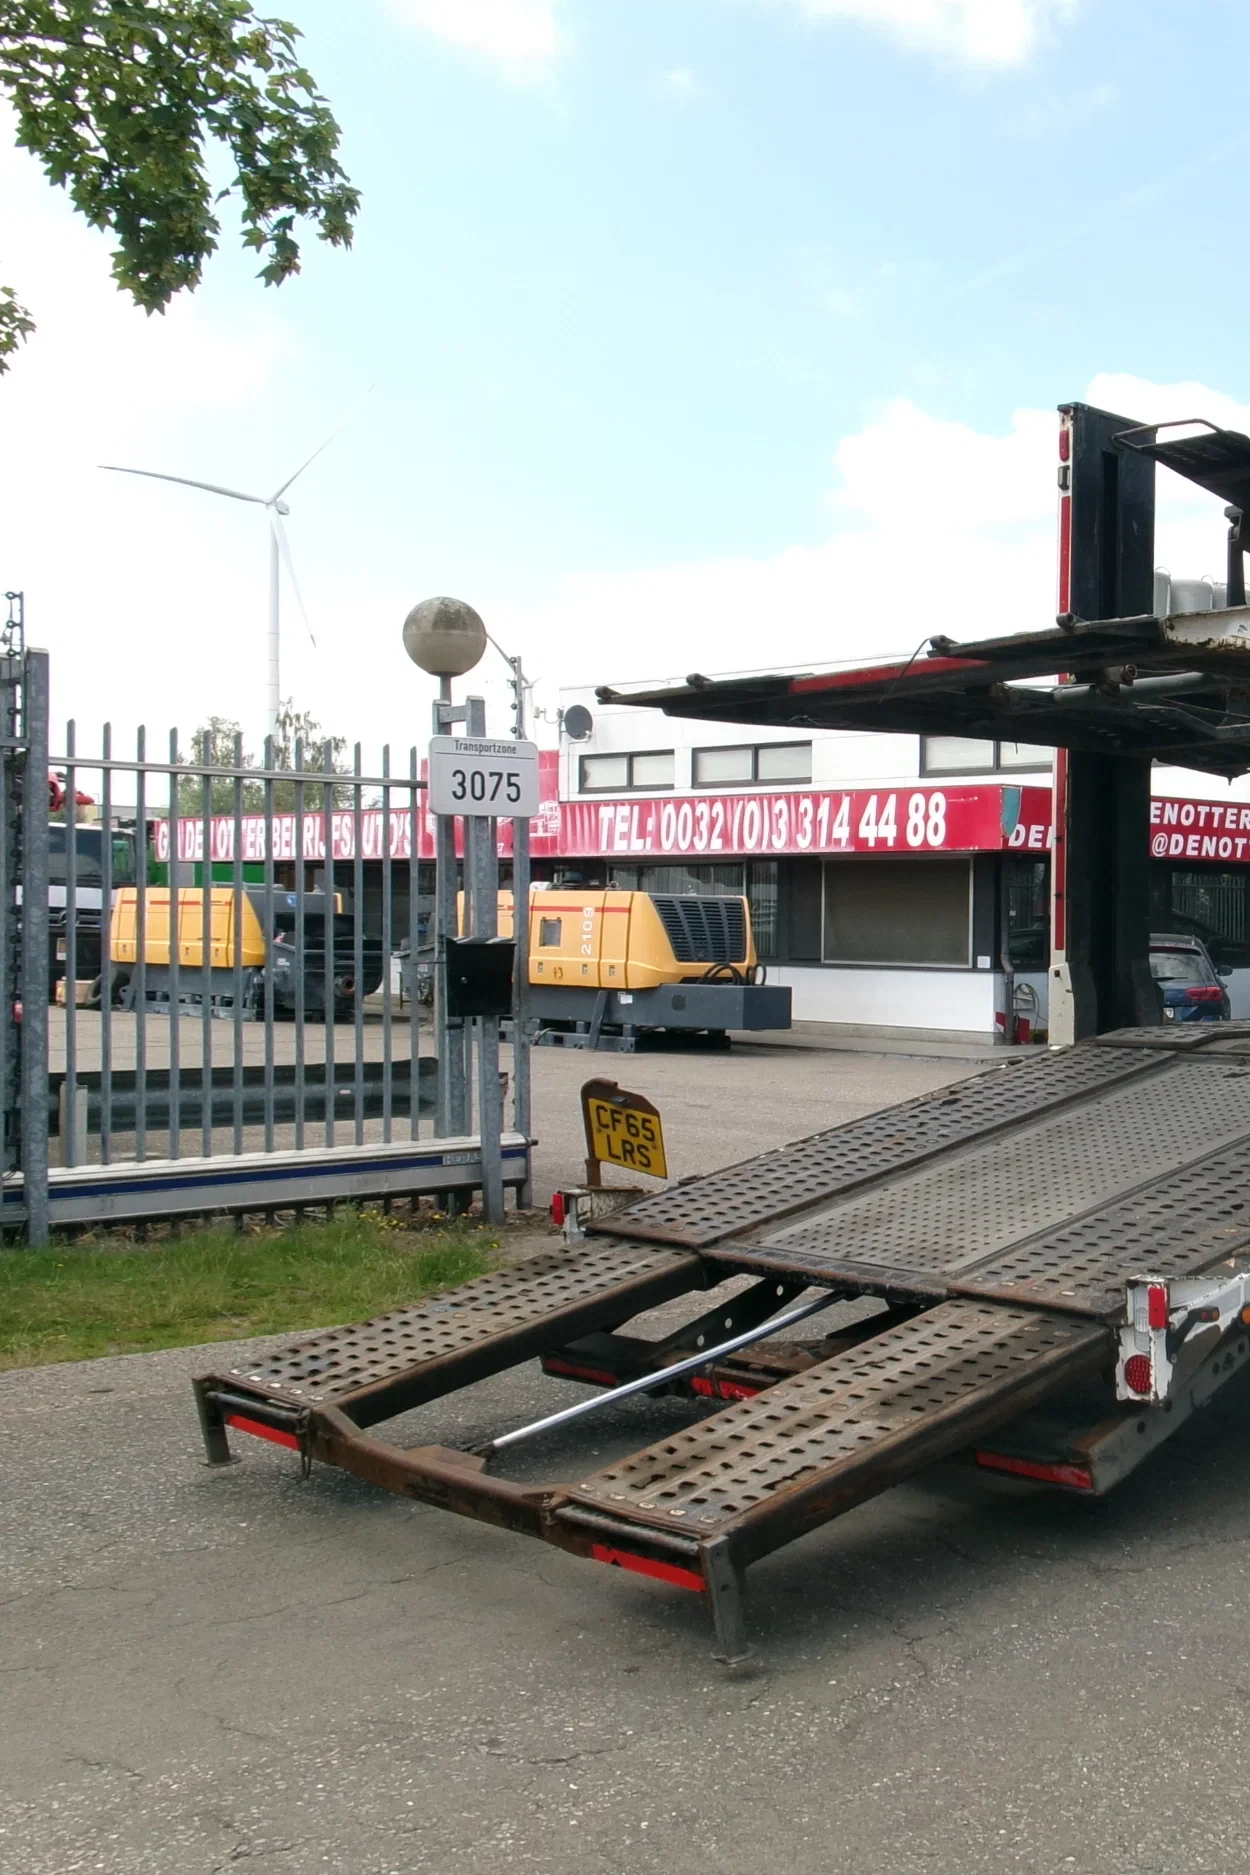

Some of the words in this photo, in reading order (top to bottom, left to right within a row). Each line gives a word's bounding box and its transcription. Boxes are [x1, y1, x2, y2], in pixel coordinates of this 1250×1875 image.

[454, 740, 517, 754] Transportzone
[452, 769, 521, 802] 3075
[598, 805, 653, 851] TEL:
[661, 802, 724, 851] 0032
[733, 800, 789, 851] (0)3
[796, 797, 850, 849] 314
[859, 793, 897, 847] 44
[906, 791, 946, 847] 88
[581, 906, 595, 955] 2109
[596, 1105, 655, 1142] CF65
[606, 1134, 651, 1168] LRS
